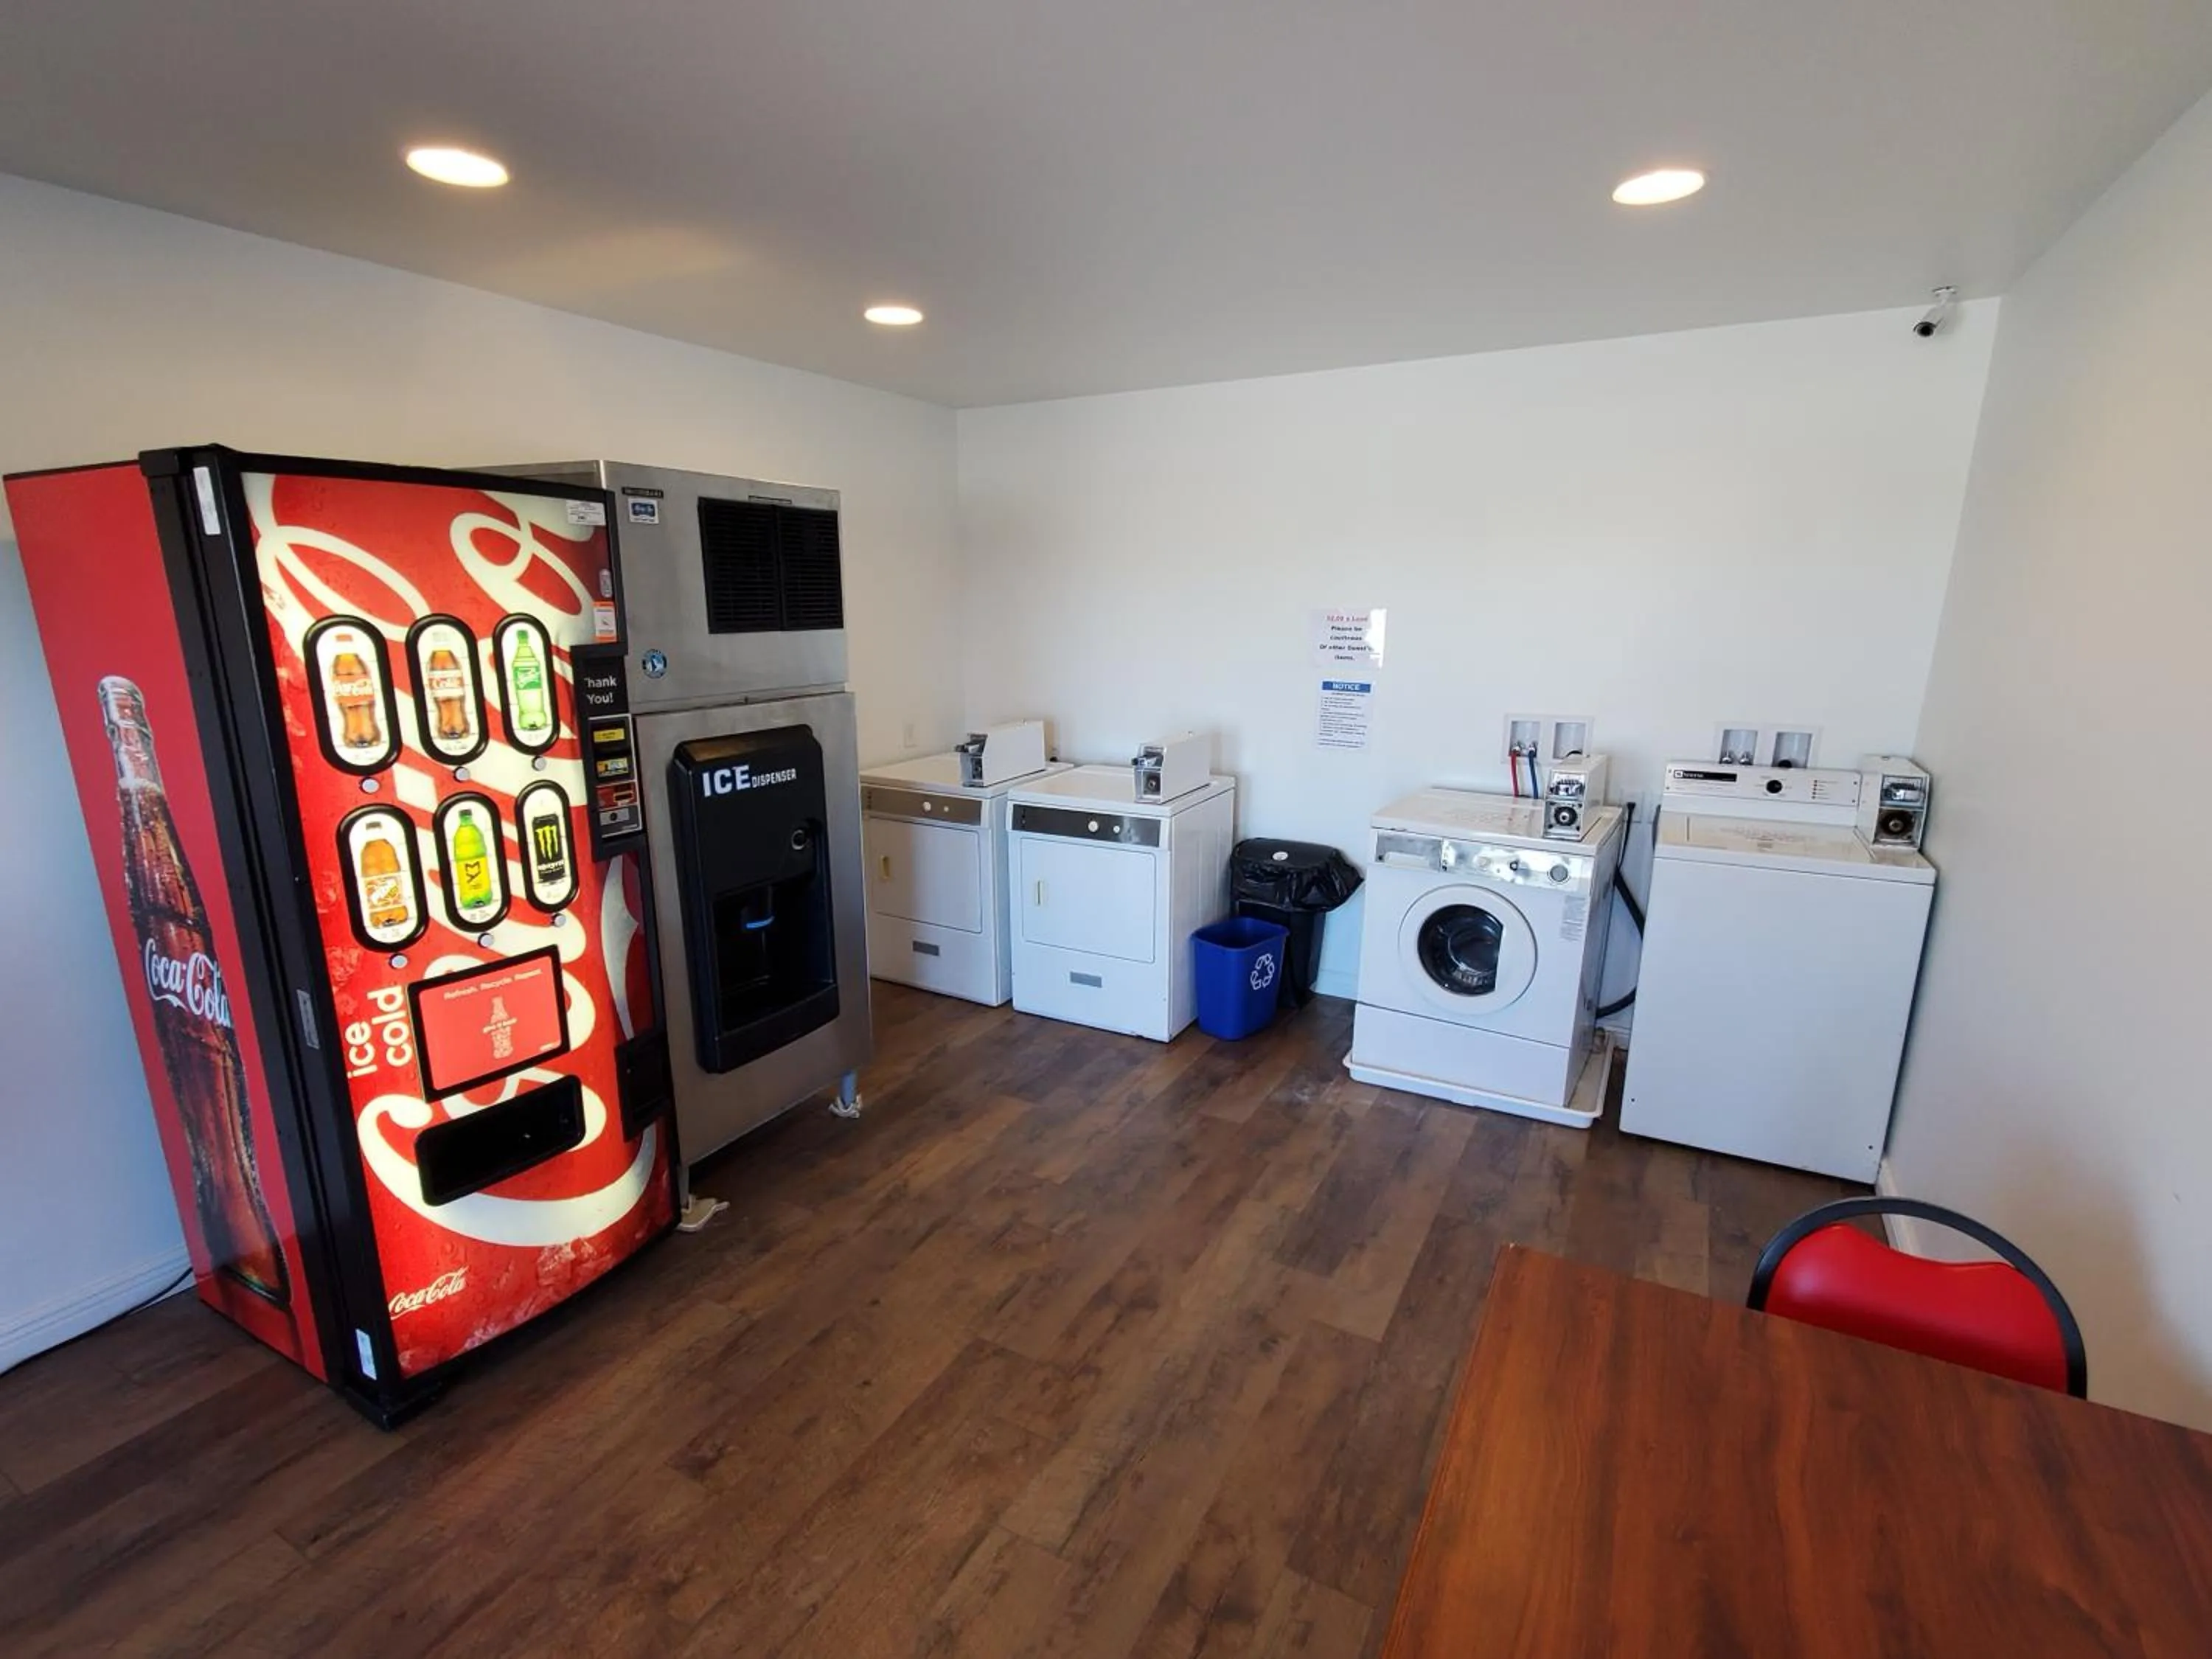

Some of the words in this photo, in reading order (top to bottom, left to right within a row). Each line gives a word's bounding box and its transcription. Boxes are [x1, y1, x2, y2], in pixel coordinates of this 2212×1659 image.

[586, 692, 614, 705] You!
[1332, 684, 1360, 692] NOTICE
[703, 765, 751, 798] ICE
[751, 768, 797, 788] DISPENSER
[145, 937, 232, 1029] Coca-Cola
[344, 1020, 378, 1079] ice
[366, 985, 413, 1068] cold
[388, 1265, 470, 1321] Coca-Cola
